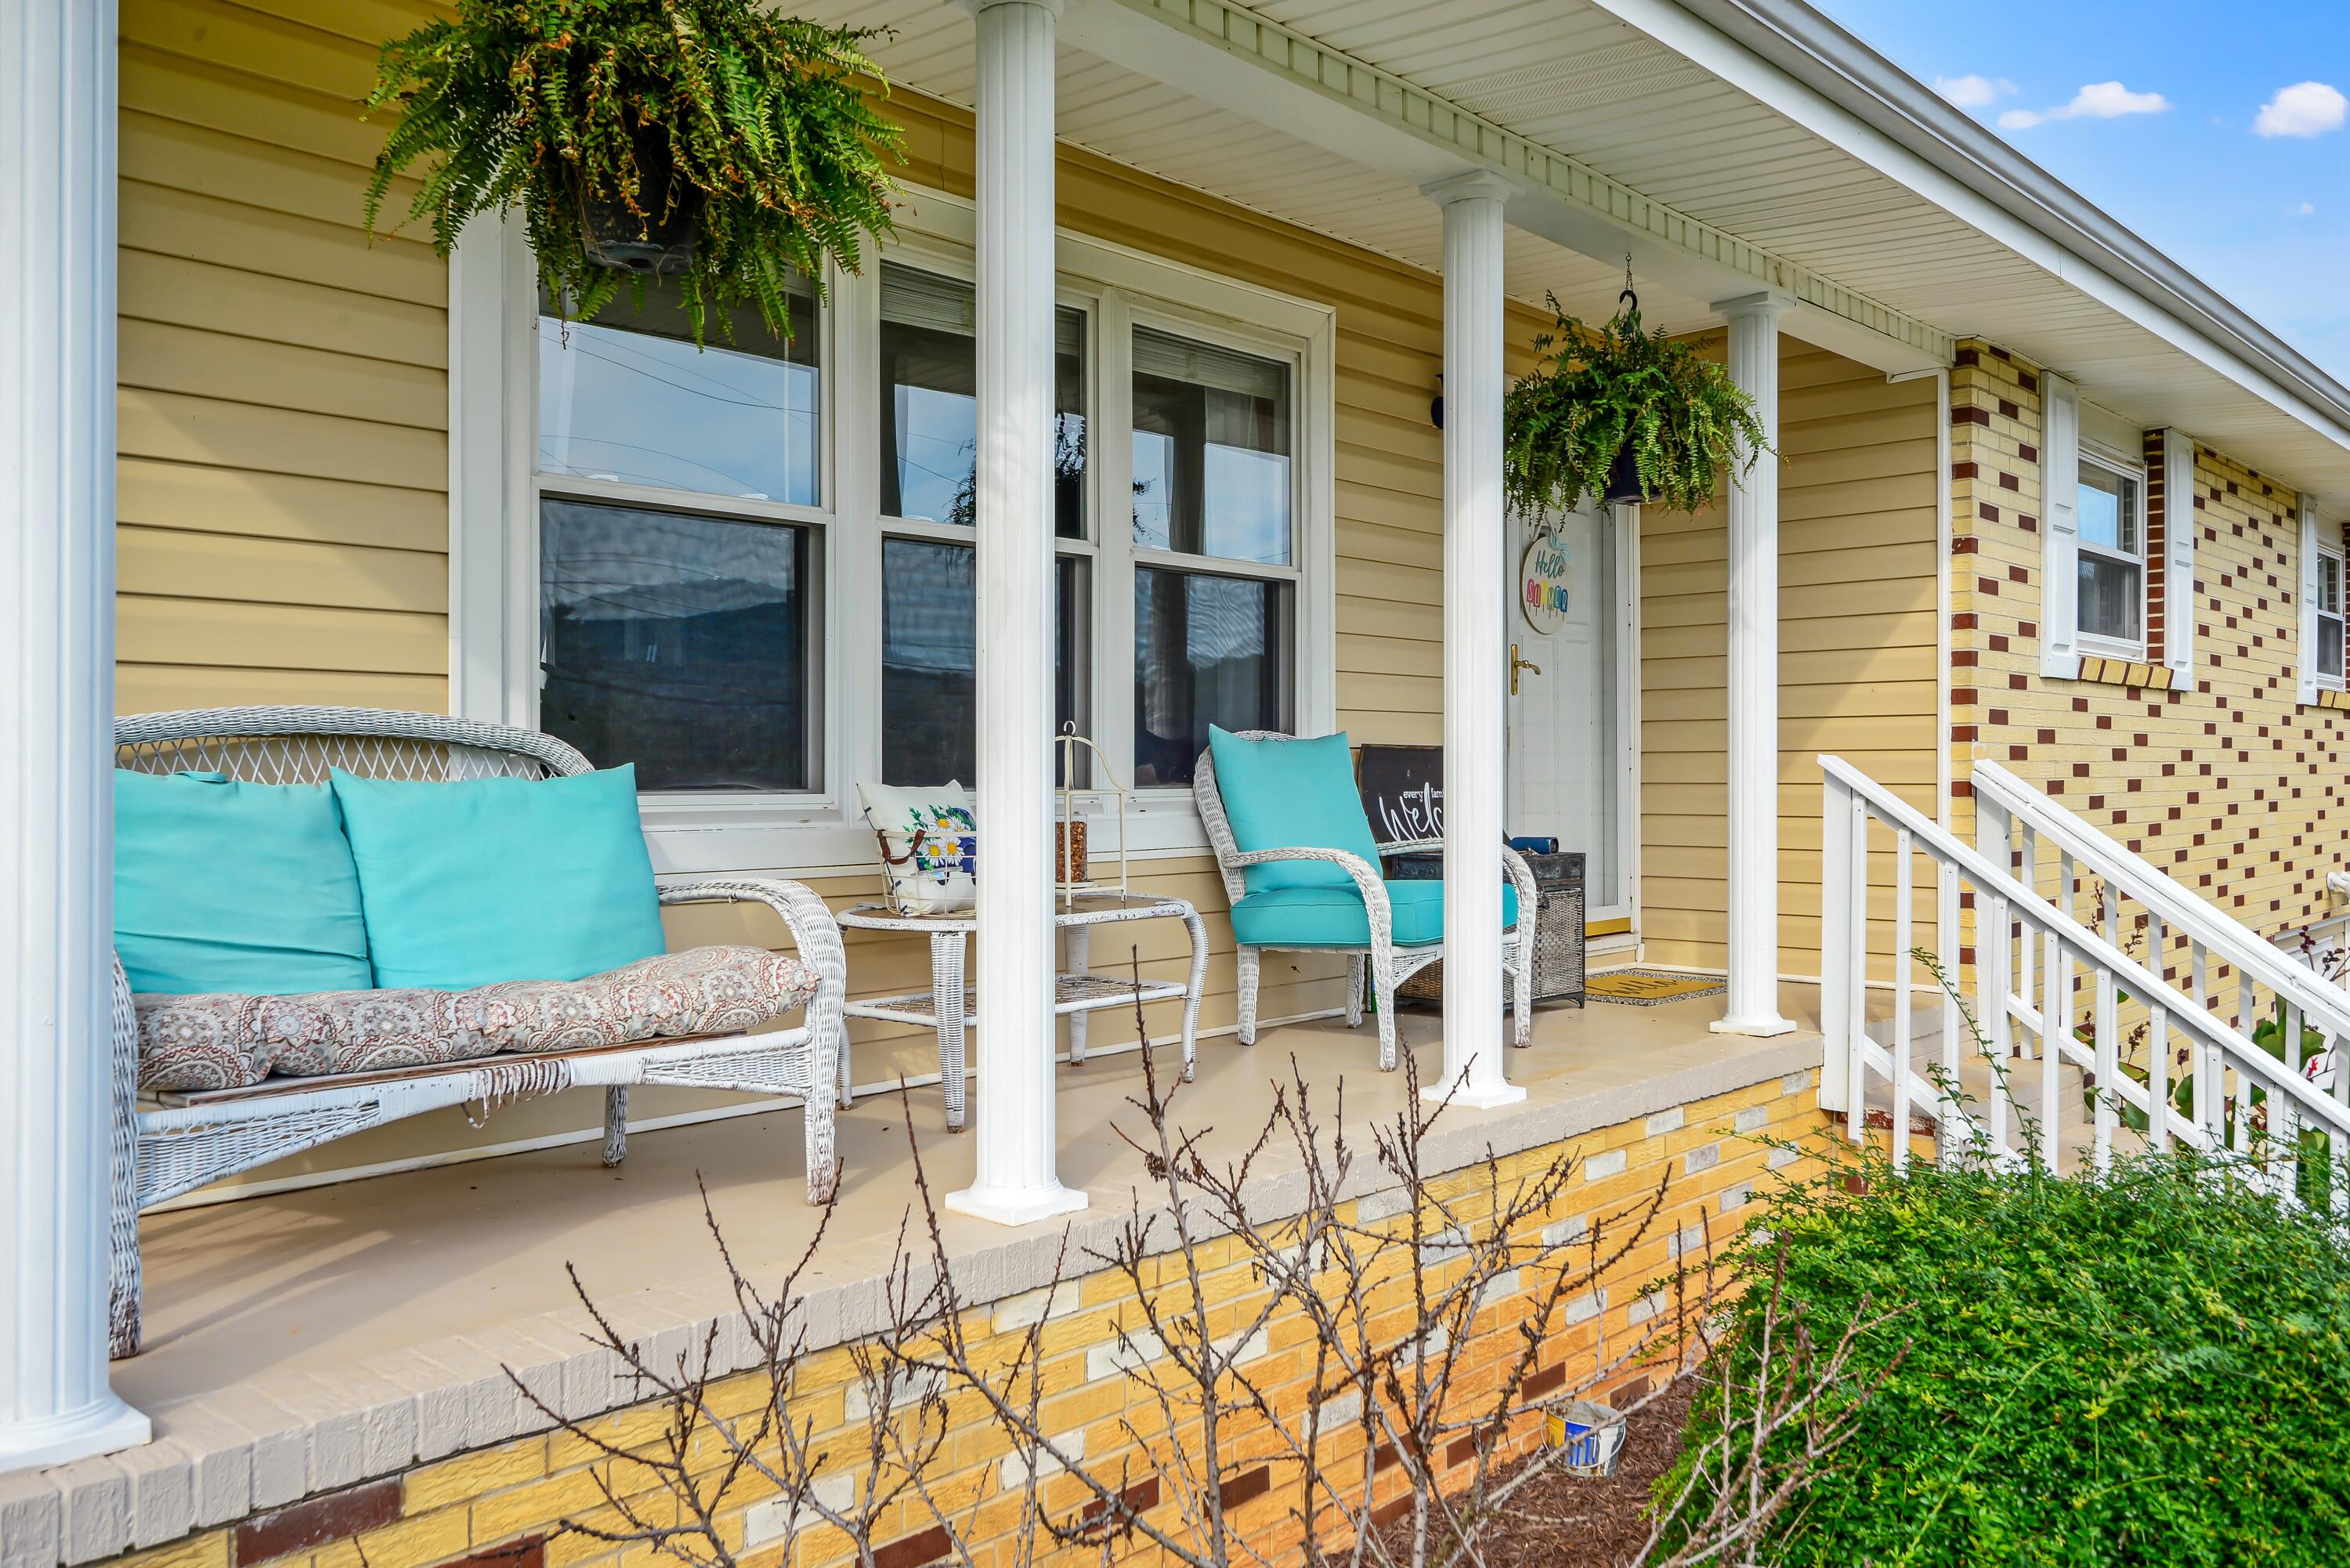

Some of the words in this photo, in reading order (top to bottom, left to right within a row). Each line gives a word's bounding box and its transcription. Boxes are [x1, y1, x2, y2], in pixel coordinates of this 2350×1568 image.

[1535, 550, 1564, 580] Hello
[1528, 580, 1567, 611] SUMER
[1403, 790, 1423, 802] every
